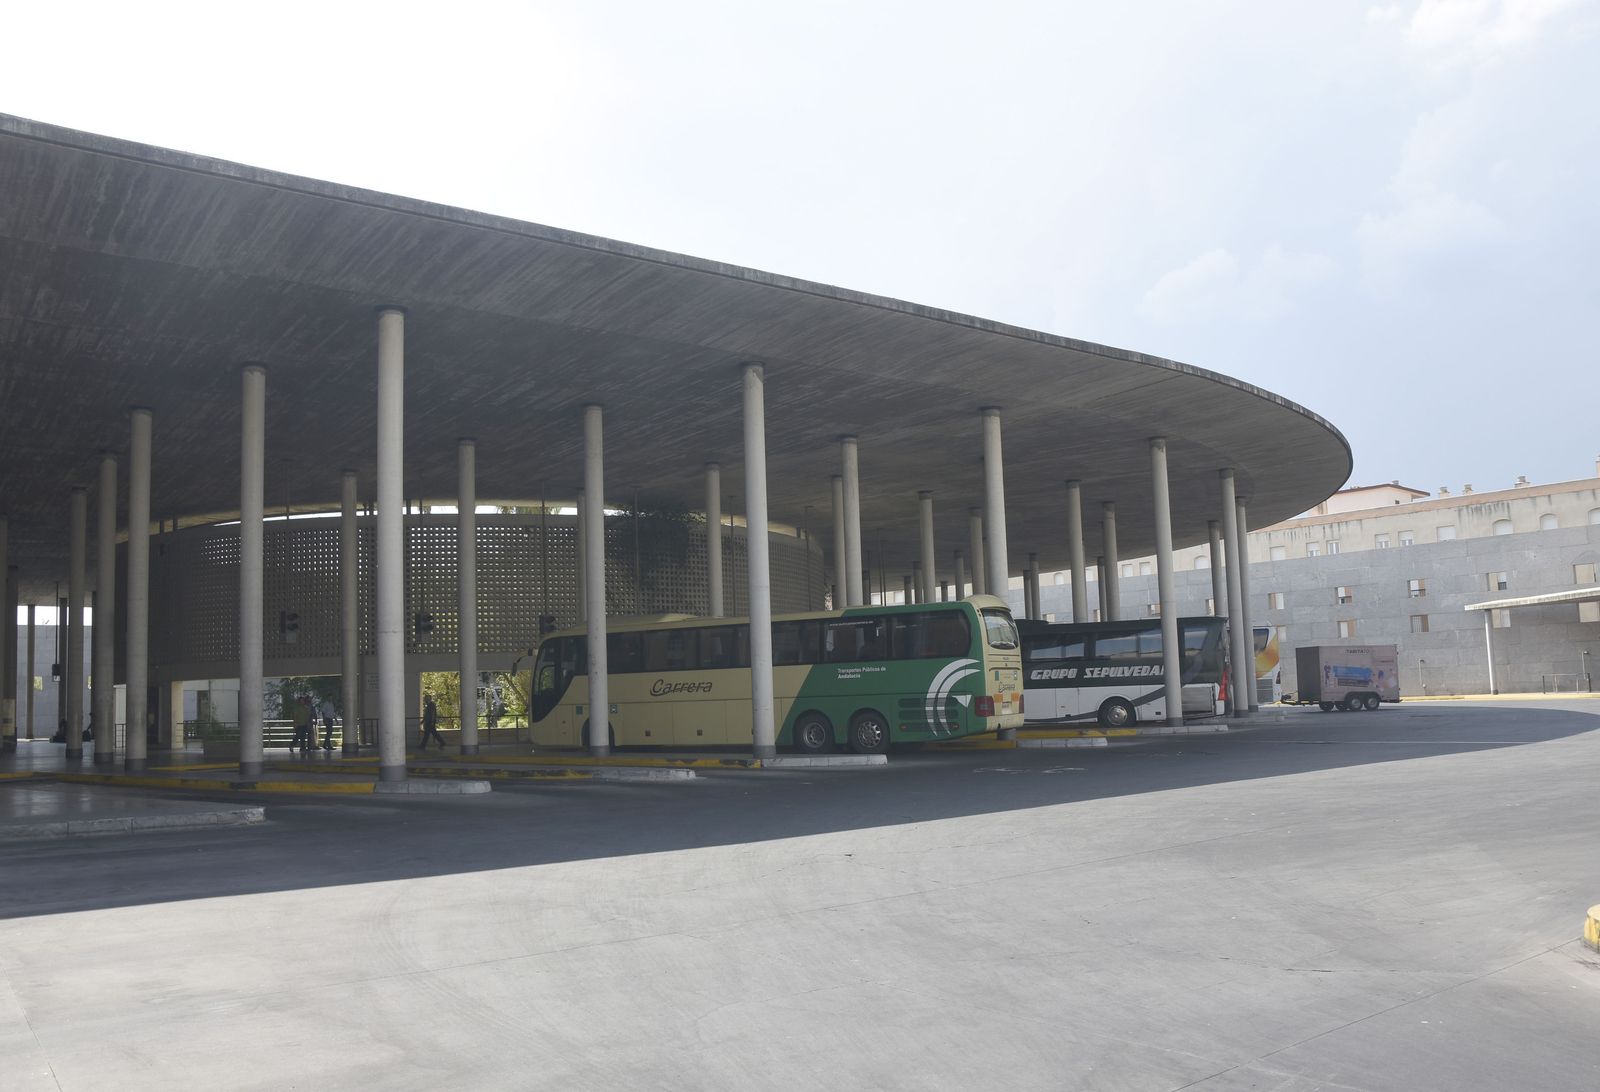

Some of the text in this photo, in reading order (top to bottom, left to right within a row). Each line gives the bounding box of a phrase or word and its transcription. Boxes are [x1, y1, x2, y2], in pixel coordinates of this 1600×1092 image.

[1030, 665, 1165, 680] GRUPO SEPULVEDA
[650, 679, 713, 696] Carrera
